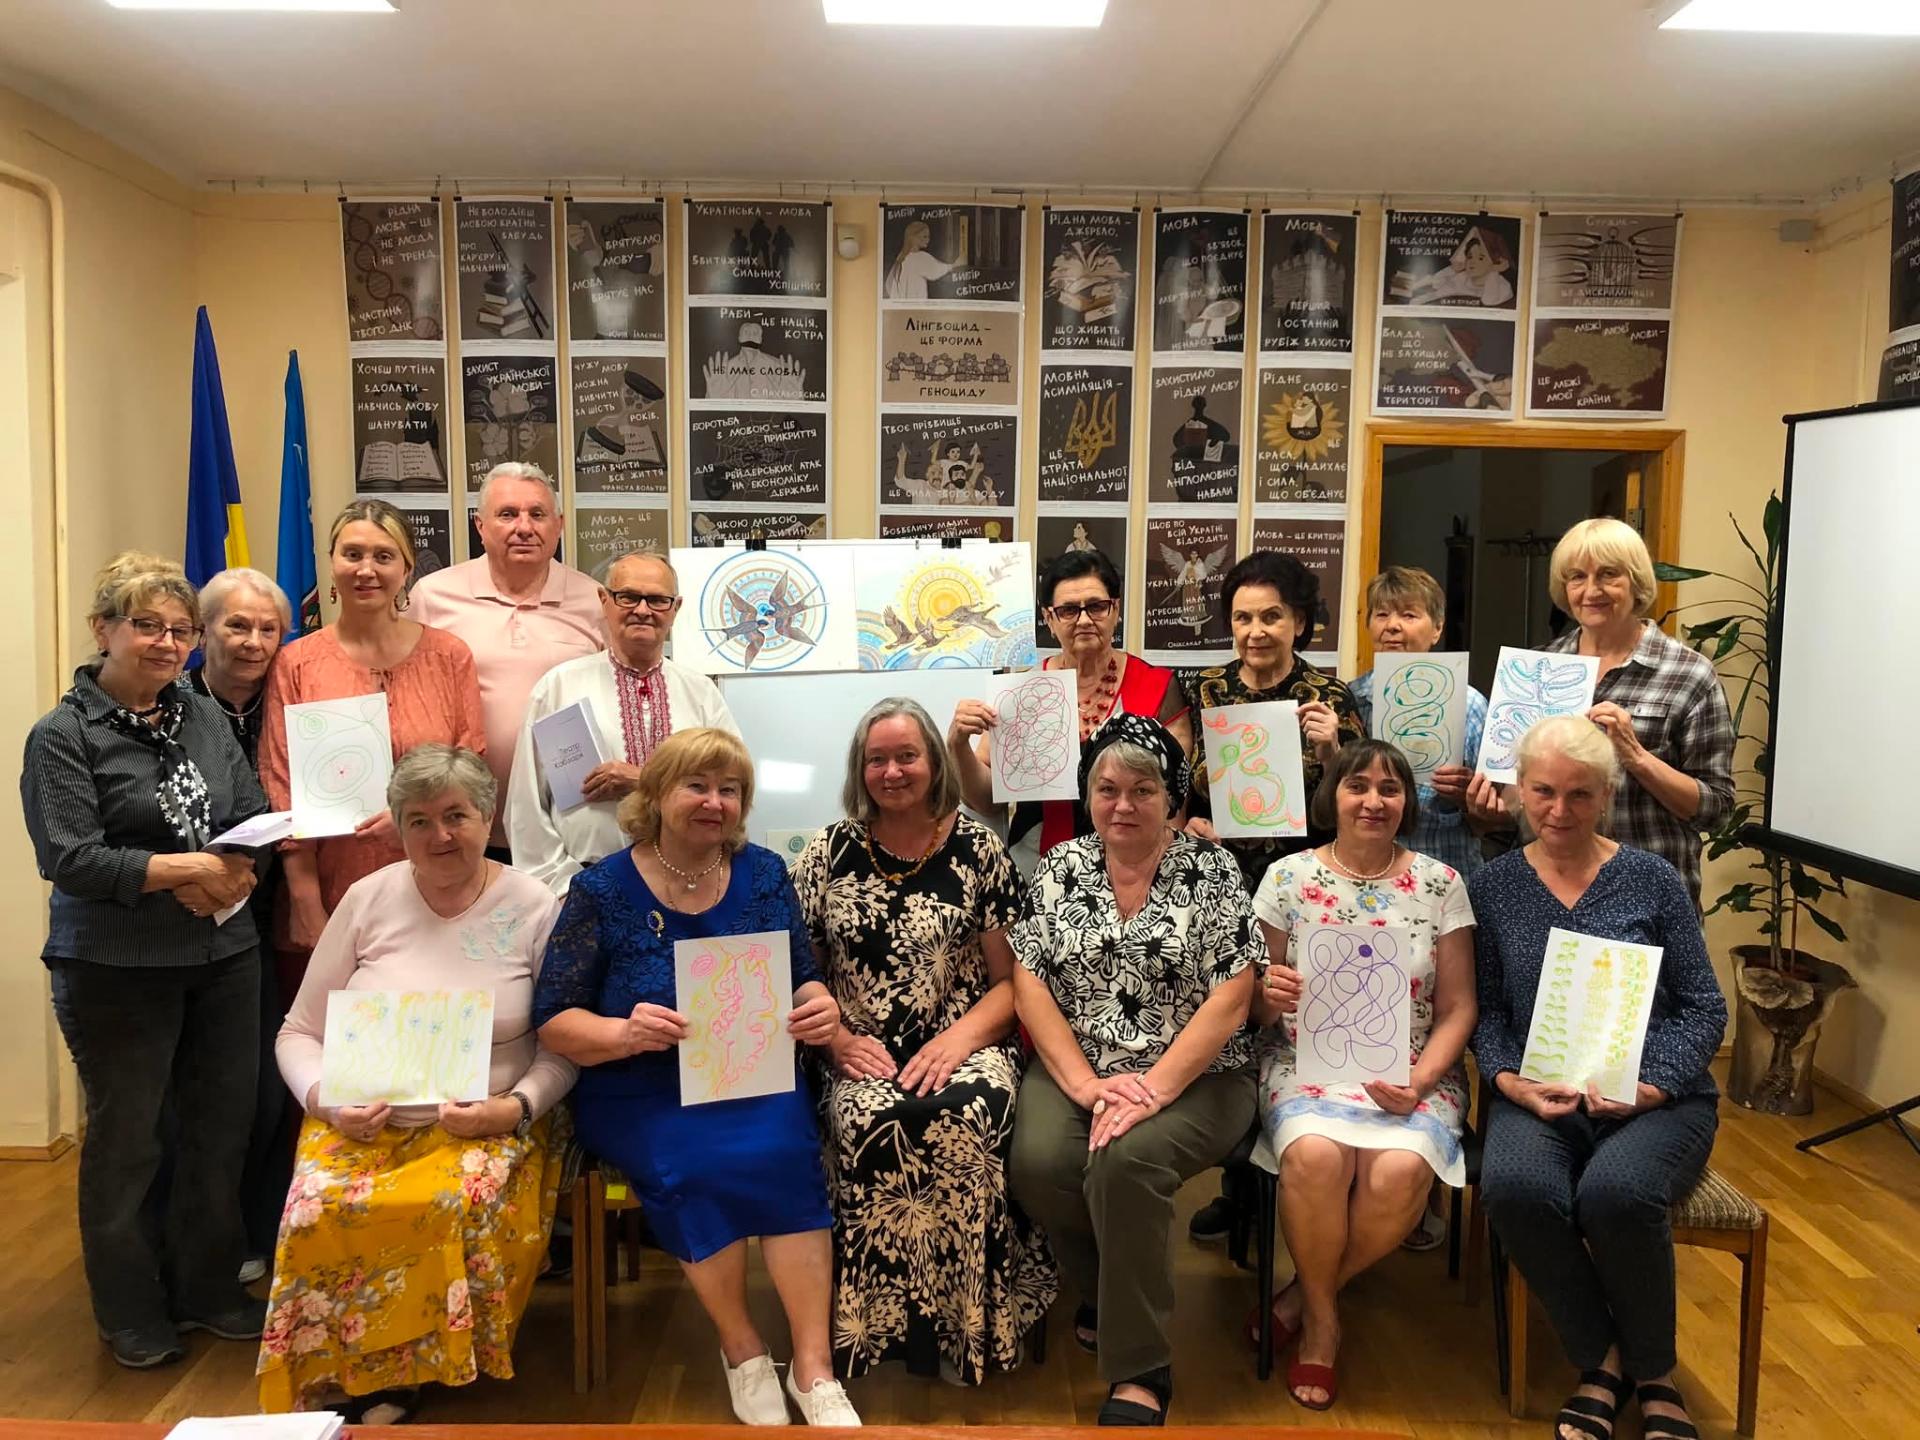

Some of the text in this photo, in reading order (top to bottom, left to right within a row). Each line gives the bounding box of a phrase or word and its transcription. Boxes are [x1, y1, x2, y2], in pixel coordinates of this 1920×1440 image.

[603, 254, 633, 266] МОВУ
[635, 285, 654, 296] НАС
[360, 306, 402, 321] ЧАСТИНА
[762, 318, 775, 327] ЦЕ
[352, 322, 413, 337] ТВОГО ДНК
[785, 330, 823, 340] КОТРА
[1056, 325, 1120, 335] ЩО ЖИВИТЬ
[920, 336, 983, 346] ЦЕ ФОРМА
[1305, 339, 1351, 347] ЗАХИСТУ
[466, 362, 499, 376] ЗАХИСТ
[575, 361, 628, 373] ЧУЖУ МОВУ
[730, 366, 756, 375] МАЄ
[487, 365, 550, 384] УКРАЇНСЬКОЇ
[1156, 368, 1215, 388] ЗАХИСТИМО
[364, 384, 418, 392] ЗДОЛАТИ
[575, 378, 608, 390] МОЖНА
[1044, 379, 1112, 399] АСИМІЛЯЦІЯ
[1304, 383, 1338, 392] СЛОВО
[1538, 376, 1580, 390] ЦЕ МЕЖІ
[920, 388, 985, 397] ГЕНОЦИДУ
[1174, 380, 1239, 399] РІДНУ МОВУ
[1398, 386, 1460, 394] ЗАХИСТИТЬ
[580, 391, 619, 403] ВИВЧИТИ
[1577, 394, 1611, 407] КРАЇНИ
[359, 403, 438, 411] НАВЧИСЬ МОВУ
[589, 404, 615, 414] ШІСТЬ
[368, 421, 427, 430] ШАНУВАТИ
[693, 416, 739, 431] БОРОТЬБА
[730, 421, 795, 437] МОВОЮ ЦЕ
[883, 416, 961, 435] ТВОЄ ПРІЗВИЩЕ
[954, 419, 1003, 436] БАТЬКОВІ
[764, 429, 816, 443] ПРИКРИТТЯ
[1049, 450, 1063, 460] ЦЕ
[582, 461, 639, 475] ТРЕБА ВЧИТИ
[694, 464, 714, 475] ДЛЯ
[725, 460, 822, 480] РЕЙДЕРСЬКИХ АТАК
[1042, 460, 1084, 475] ВТРАТА
[1175, 460, 1195, 472] ВІД
[1270, 463, 1289, 472] ЩО
[609, 469, 664, 482] ВСЕ ЖИТТЯ
[1044, 466, 1128, 488] НАЦІОНАЛЬНОЇ
[1167, 465, 1238, 488] АНГЛОМОВНОЇ
[732, 474, 808, 490] НА ЕКОНОМІКУ
[1096, 479, 1126, 494] ДУШІ
[770, 484, 819, 498] ДЕРЖАВИ
[889, 489, 901, 497] ЦЕ
[1197, 487, 1232, 500] НАВАЛИ
[1269, 490, 1288, 500] ЩО
[639, 512, 652, 521] ЦЕ
[717, 519, 748, 529] ЯКОЮ
[615, 527, 630, 536] ДЕ
[1176, 534, 1228, 546] ВІДРОДИТИ
